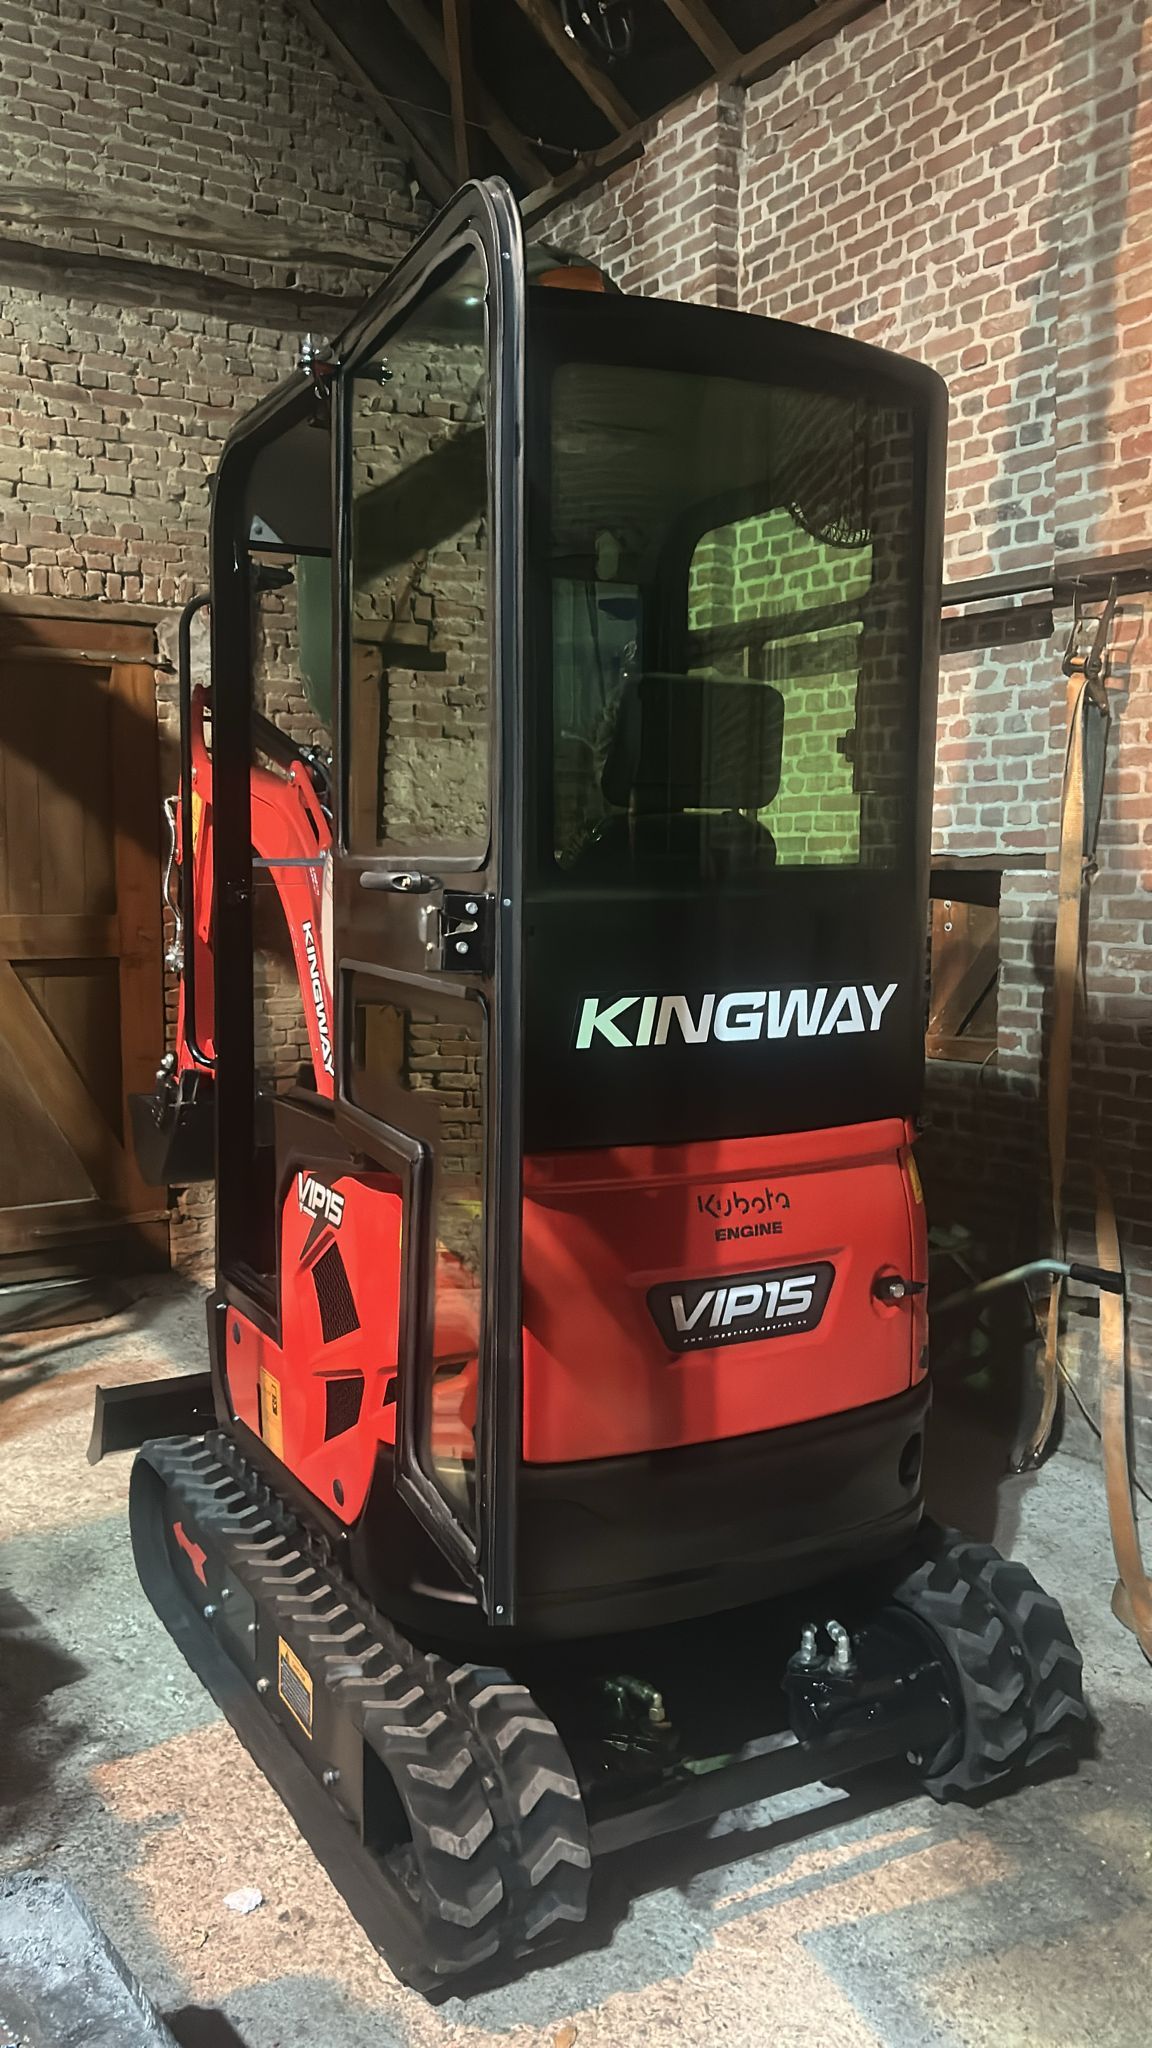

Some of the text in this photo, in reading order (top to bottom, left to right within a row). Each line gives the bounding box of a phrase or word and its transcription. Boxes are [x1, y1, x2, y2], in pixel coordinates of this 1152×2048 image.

[302, 921, 335, 1077] KINGWAY
[575, 983, 898, 1049] KINGWAY
[298, 1171, 345, 1226] VIP15
[697, 1187, 791, 1218] Kubota
[715, 1221, 783, 1241] ENGINE
[671, 1274, 816, 1332] VIP15
